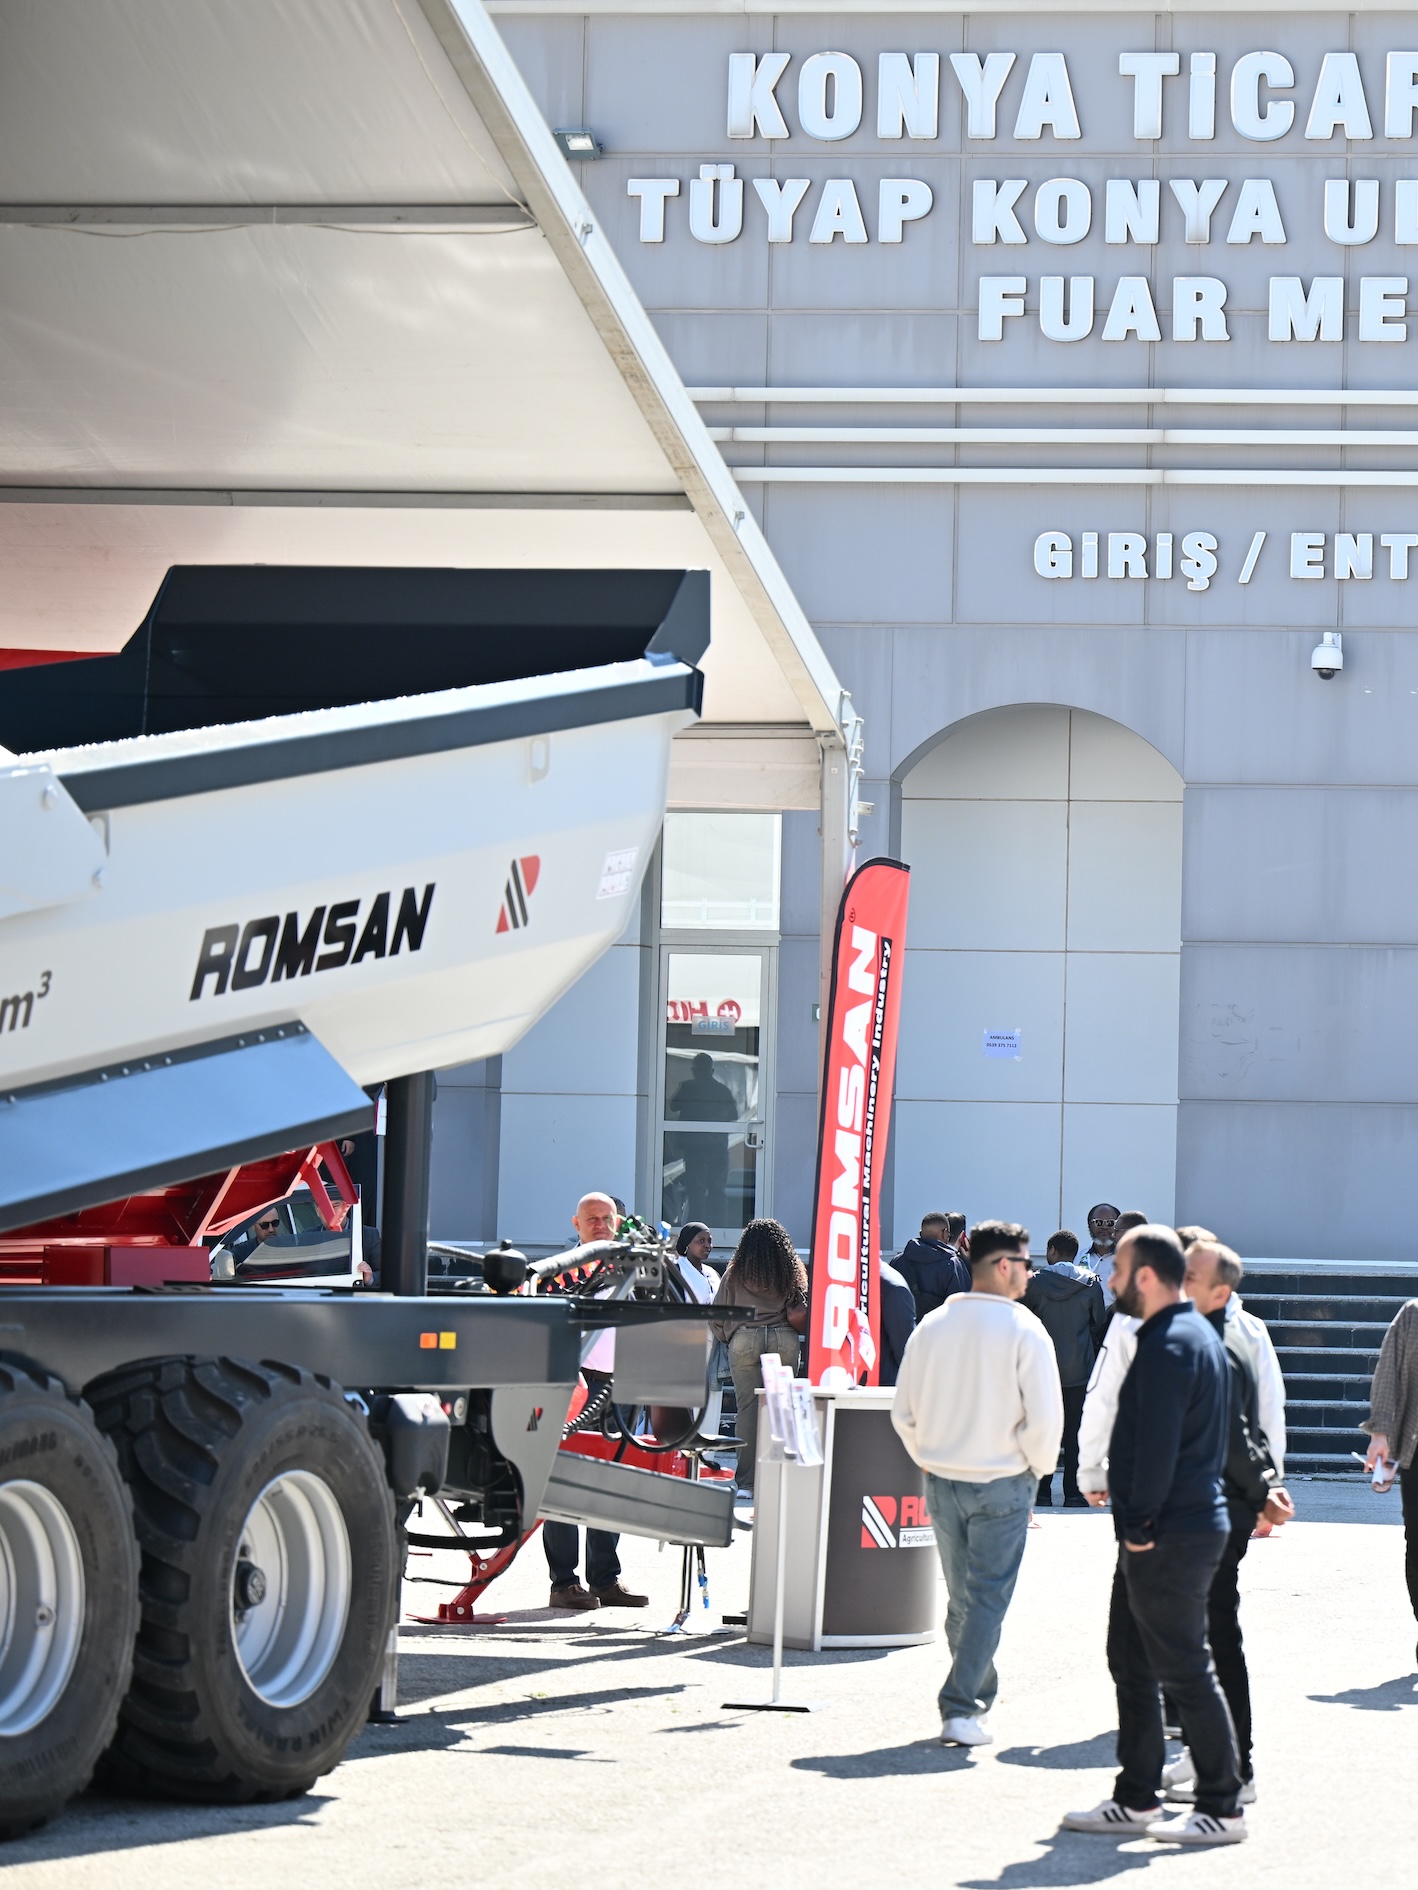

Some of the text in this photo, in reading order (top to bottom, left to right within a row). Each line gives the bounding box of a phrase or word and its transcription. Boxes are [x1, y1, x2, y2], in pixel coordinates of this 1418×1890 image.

[726, 51, 1082, 141] KONYA
[627, 163, 933, 245] TÜYAP
[972, 177, 1287, 245] KONYA
[978, 275, 1231, 343] FUAR
[1033, 530, 1219, 591] GİRİŞ
[188, 882, 437, 1002] ROMSAN
[698, 1019, 729, 1032] GİRİŞ
[872, 941, 891, 1048] Industry
[822, 925, 877, 1351] ROMSAN
[863, 1054, 880, 1188] Machinery
[860, 1195, 870, 1315] ricultural
